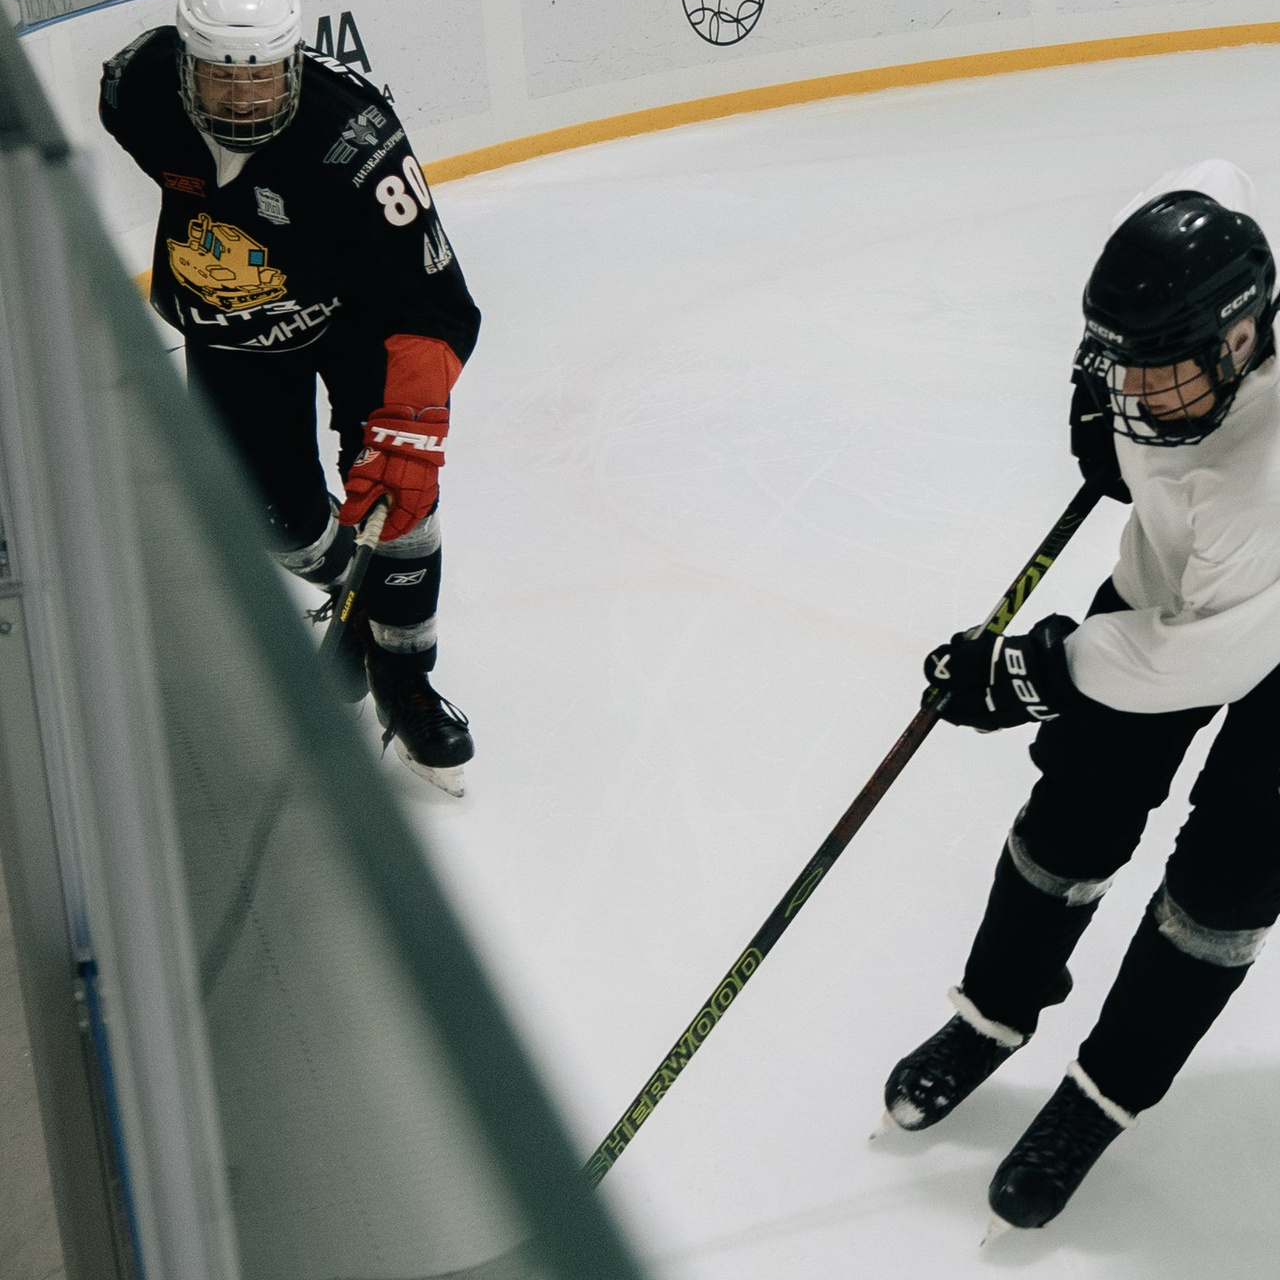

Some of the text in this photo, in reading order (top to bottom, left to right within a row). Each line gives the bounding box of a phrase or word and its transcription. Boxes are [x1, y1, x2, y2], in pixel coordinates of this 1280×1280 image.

[375, 155, 431, 227] 80
[1220, 285, 1258, 320] CCM
[1087, 321, 1124, 344] CCM
